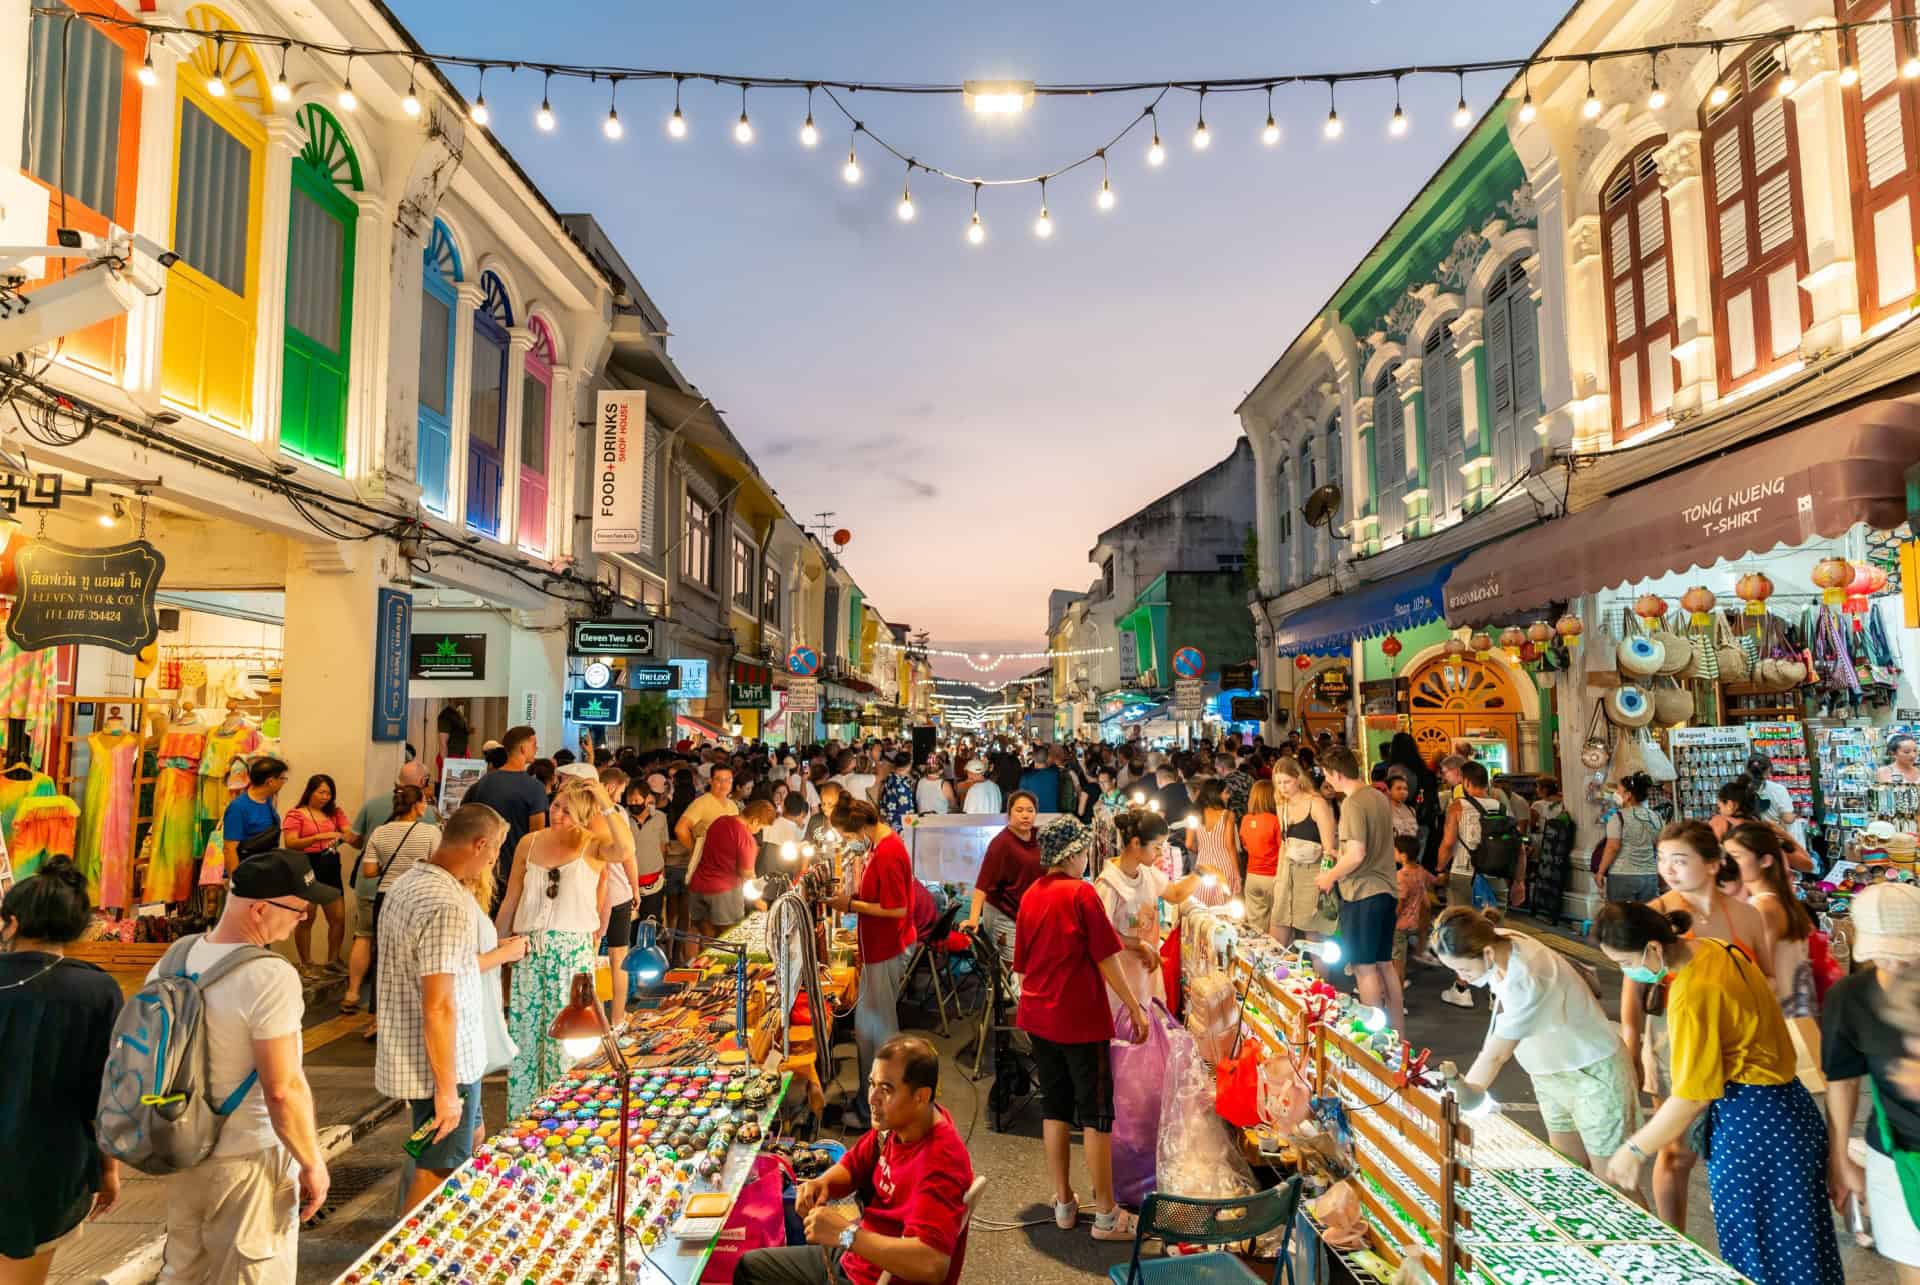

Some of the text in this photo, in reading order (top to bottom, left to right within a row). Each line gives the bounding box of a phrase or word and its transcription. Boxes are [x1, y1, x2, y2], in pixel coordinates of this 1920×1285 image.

[620, 404, 629, 434] HOUSE
[1682, 476, 1785, 523] TONG NUENG
[1702, 508, 1762, 536] T-SHIRT
[32, 591, 75, 603] ELEVEN
[79, 593, 103, 604] TWO
[105, 595, 114, 605] &
[580, 633, 647, 643] Eleven Two & Co.
